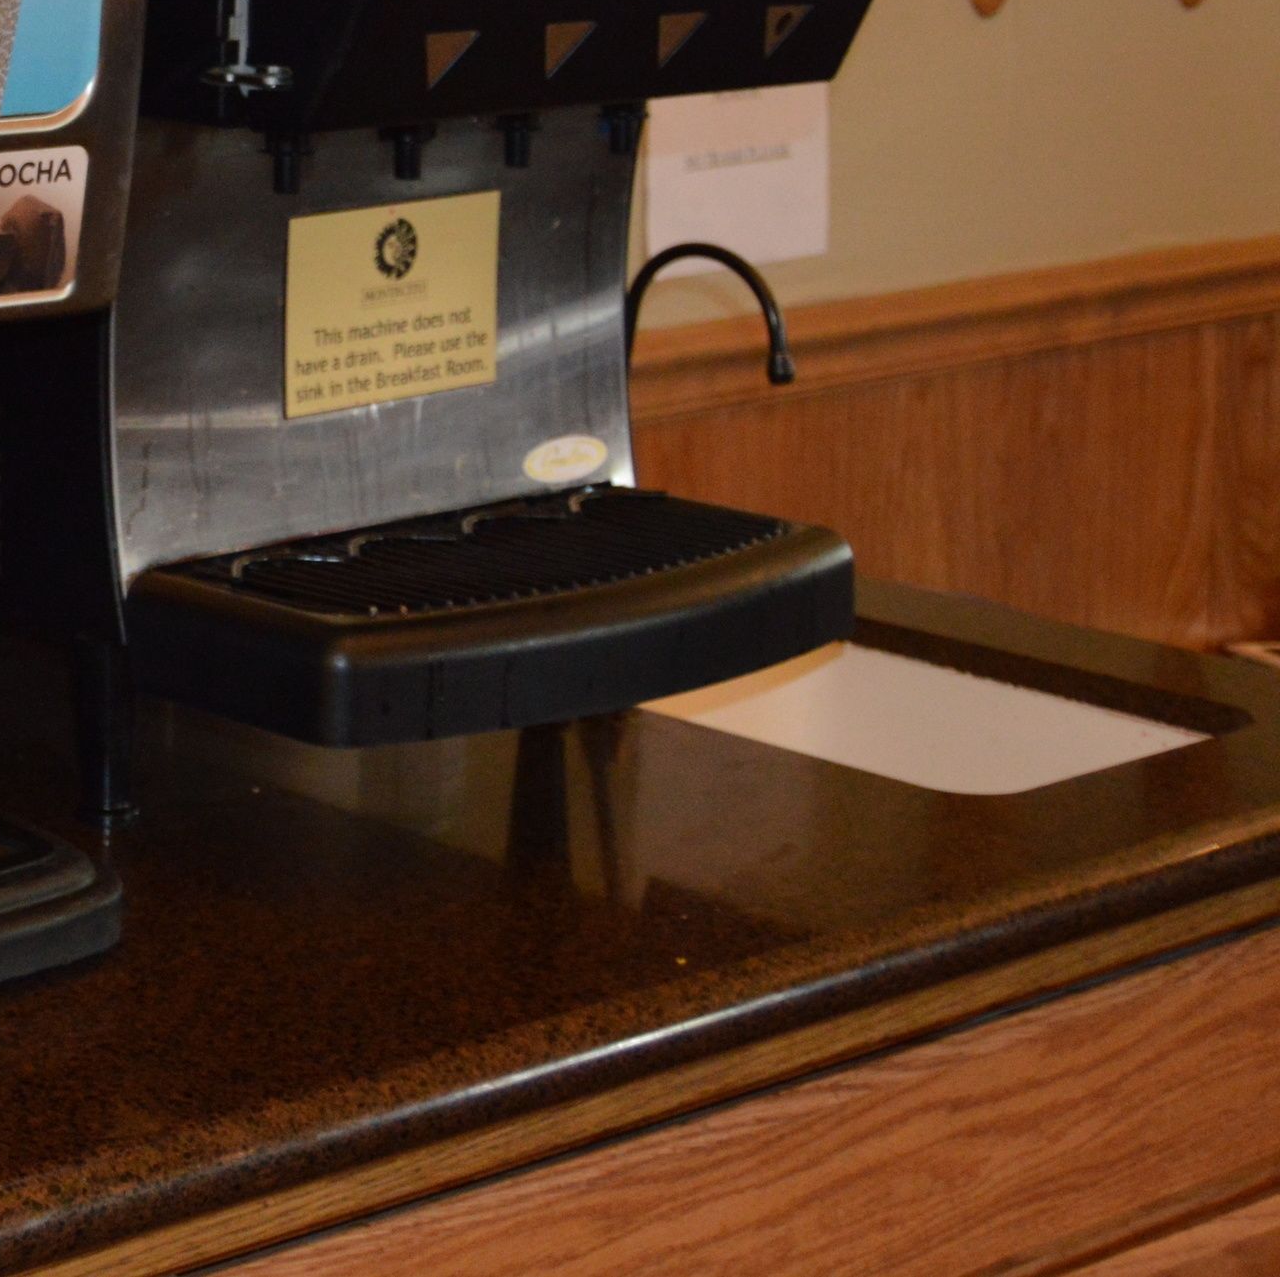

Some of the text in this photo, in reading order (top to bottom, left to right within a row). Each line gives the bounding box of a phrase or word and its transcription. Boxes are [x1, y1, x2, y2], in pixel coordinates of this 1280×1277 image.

[313, 307, 472, 347] This machine does not
[295, 330, 487, 375] have a drain. Please use the
[295, 357, 488, 404] sink in the Breakfast Room.
